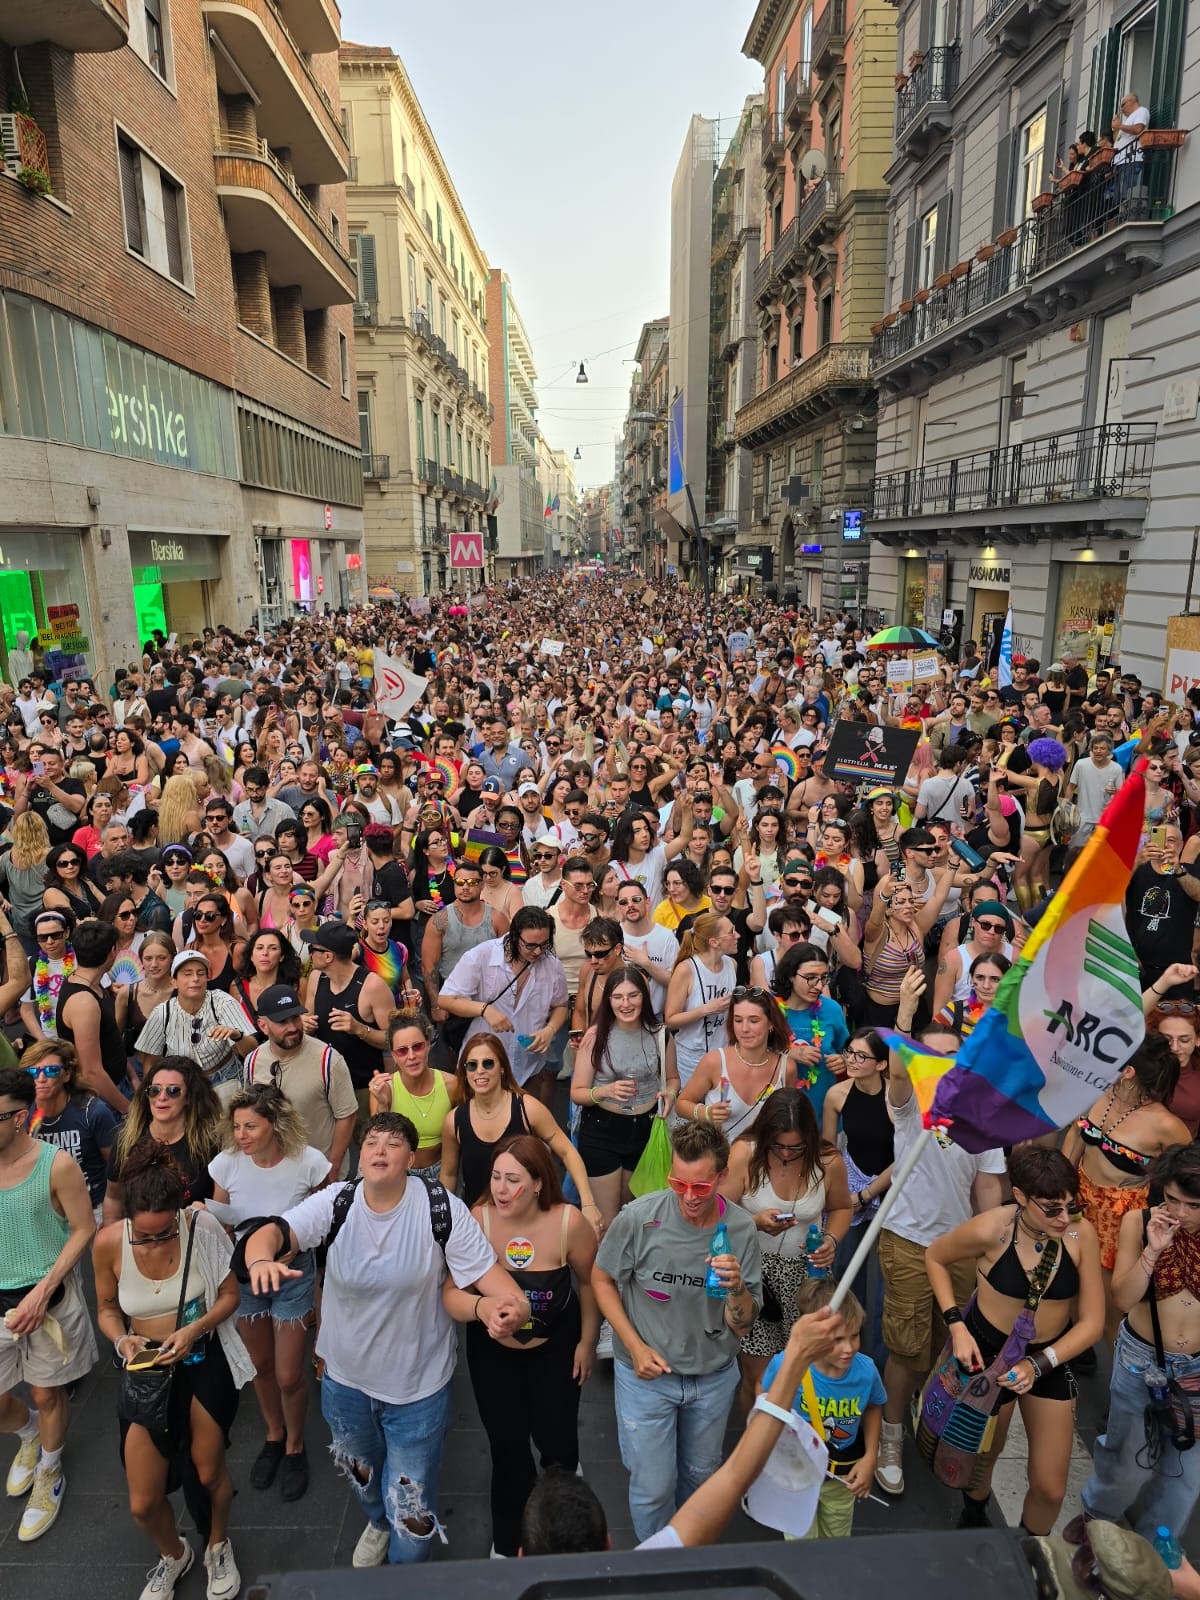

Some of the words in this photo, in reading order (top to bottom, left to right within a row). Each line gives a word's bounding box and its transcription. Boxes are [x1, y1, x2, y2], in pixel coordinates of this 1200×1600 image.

[150, 540, 184, 561] Bershka
[453, 540, 481, 560] M
[652, 1271, 707, 1288] carha
